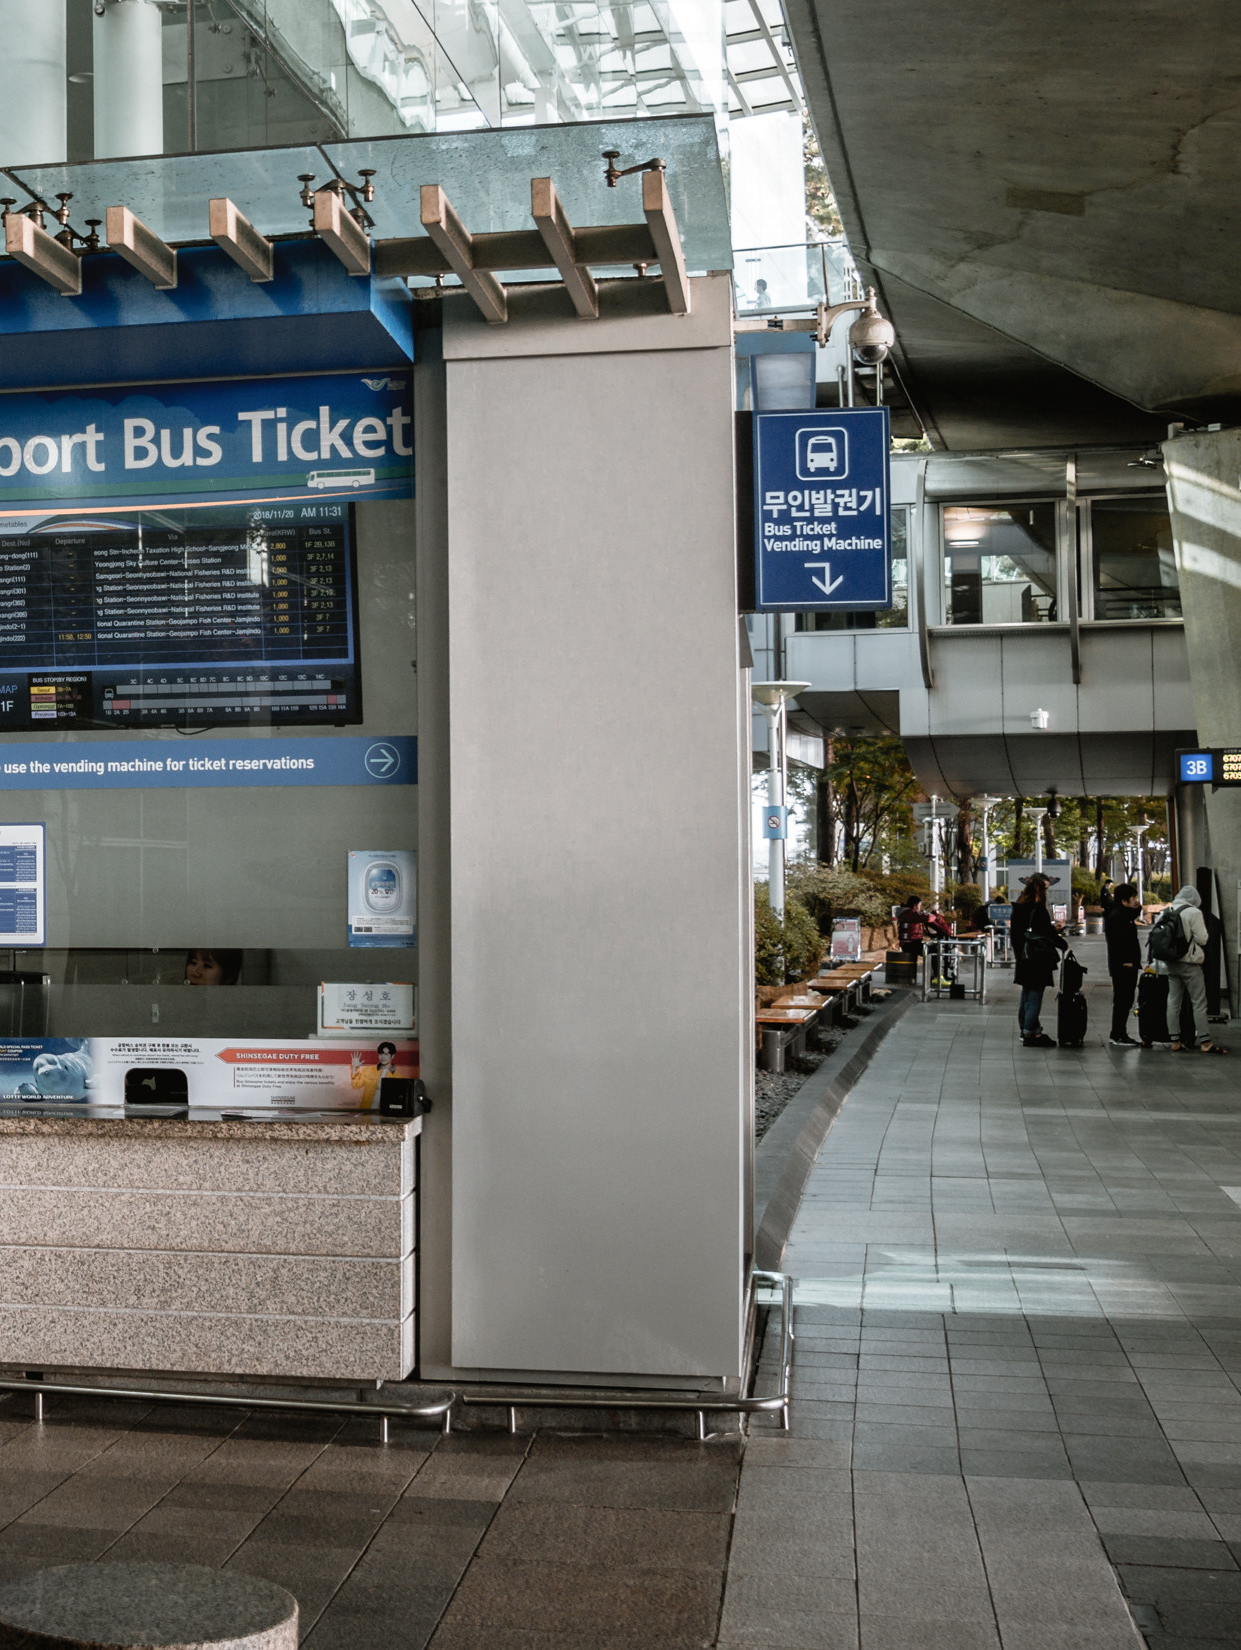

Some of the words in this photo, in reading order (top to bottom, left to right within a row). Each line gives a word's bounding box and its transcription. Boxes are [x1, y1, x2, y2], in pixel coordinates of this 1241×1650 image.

[124, 417, 223, 469] Bus
[238, 405, 414, 463] Ticket
[763, 487, 881, 518] 무인발권기
[253, 510, 294, 519] 2018/11/20
[300, 508, 317, 517] AM
[319, 506, 342, 516] 11:31
[764, 523, 792, 536] Bus
[793, 521, 837, 535] Ticket
[55, 537, 85, 545] Departure
[764, 537, 821, 553] Vending
[823, 536, 883, 550] Machine
[94, 560, 125, 568] Yeongjong
[320, 601, 334, 609] 2,13
[76, 632, 92, 640] 12:50
[0, 700, 14, 712] 1F
[4, 762, 27, 774] use
[30, 760, 51, 773] the
[53, 759, 105, 775] vending
[108, 758, 163, 772] machine
[166, 757, 186, 771] for
[188, 757, 226, 771] ticket
[229, 756, 315, 770] reservations
[1186, 760, 1207, 775] 3B
